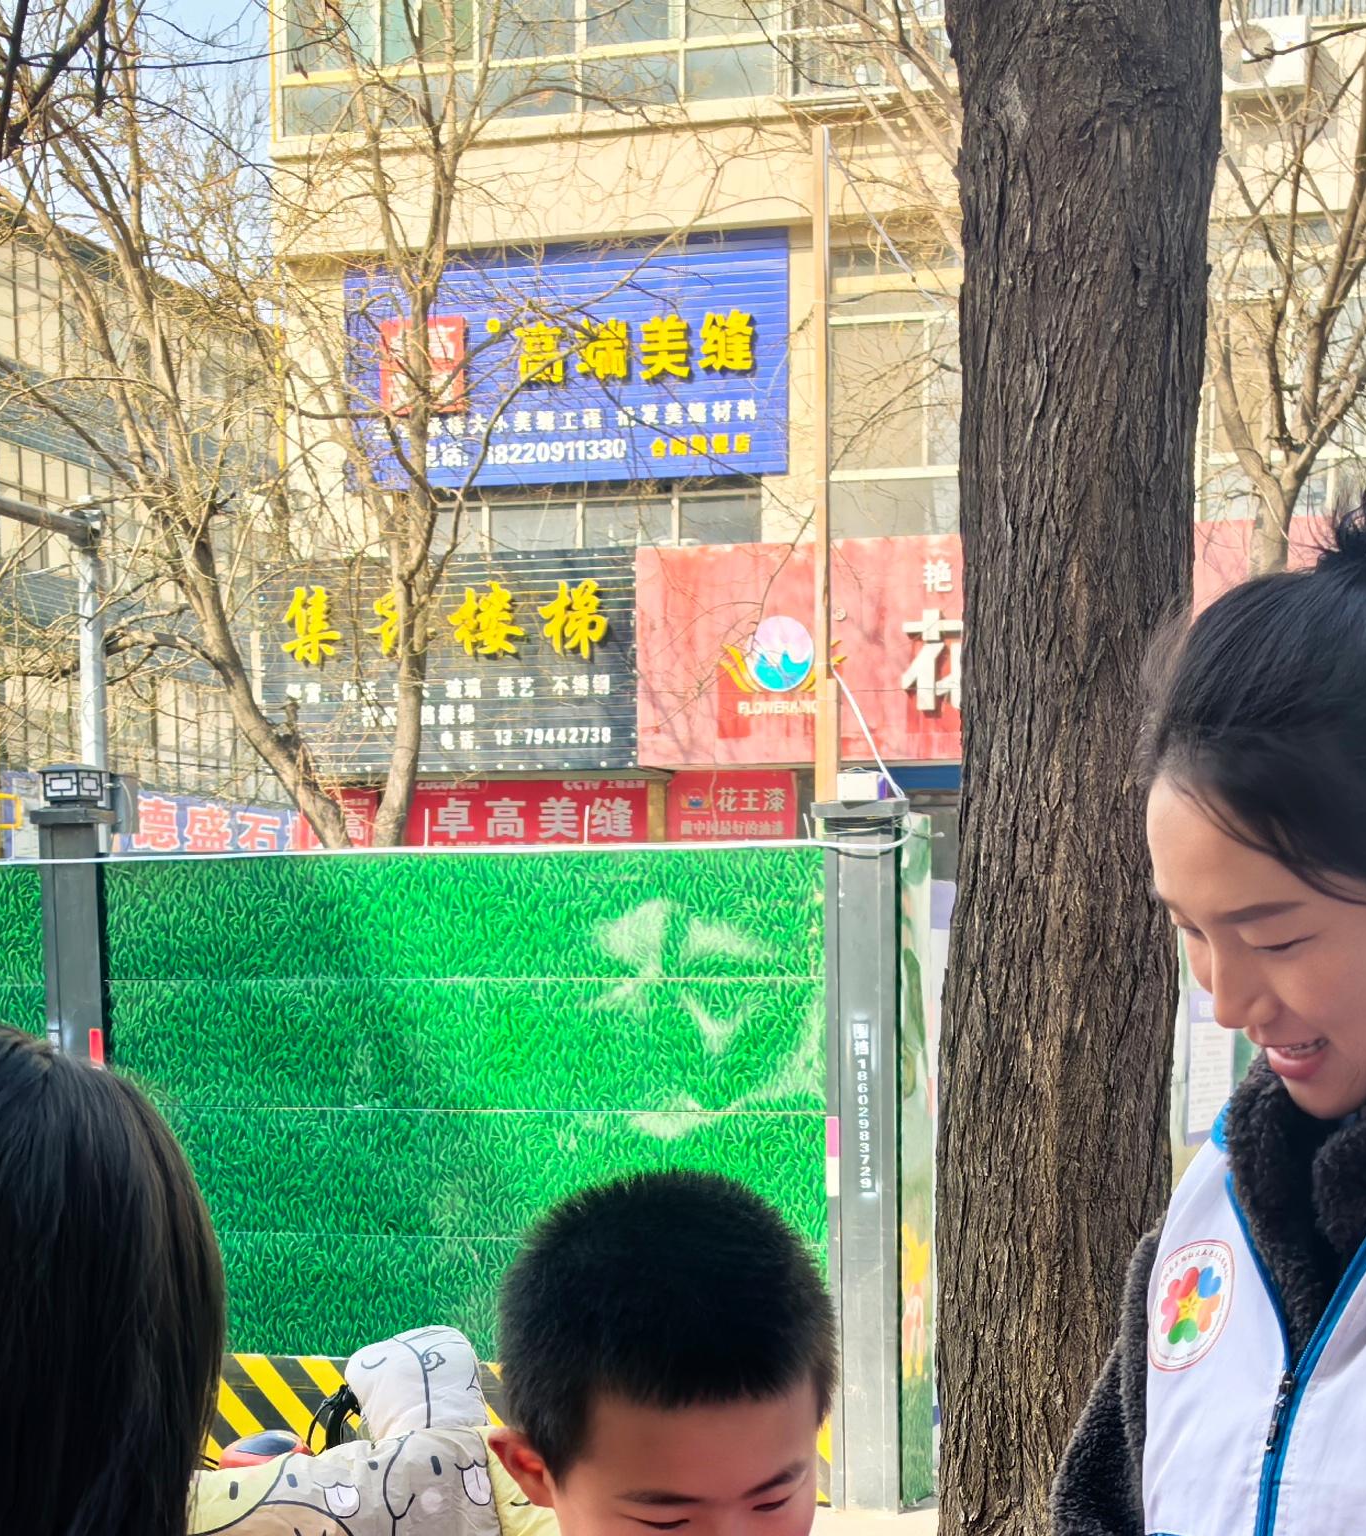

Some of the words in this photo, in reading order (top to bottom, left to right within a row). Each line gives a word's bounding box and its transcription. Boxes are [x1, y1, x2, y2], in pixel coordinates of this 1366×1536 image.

[494, 726, 612, 746] 1379442738
[716, 787, 787, 813] 花王漆
[432, 797, 634, 841] 卓高美缝
